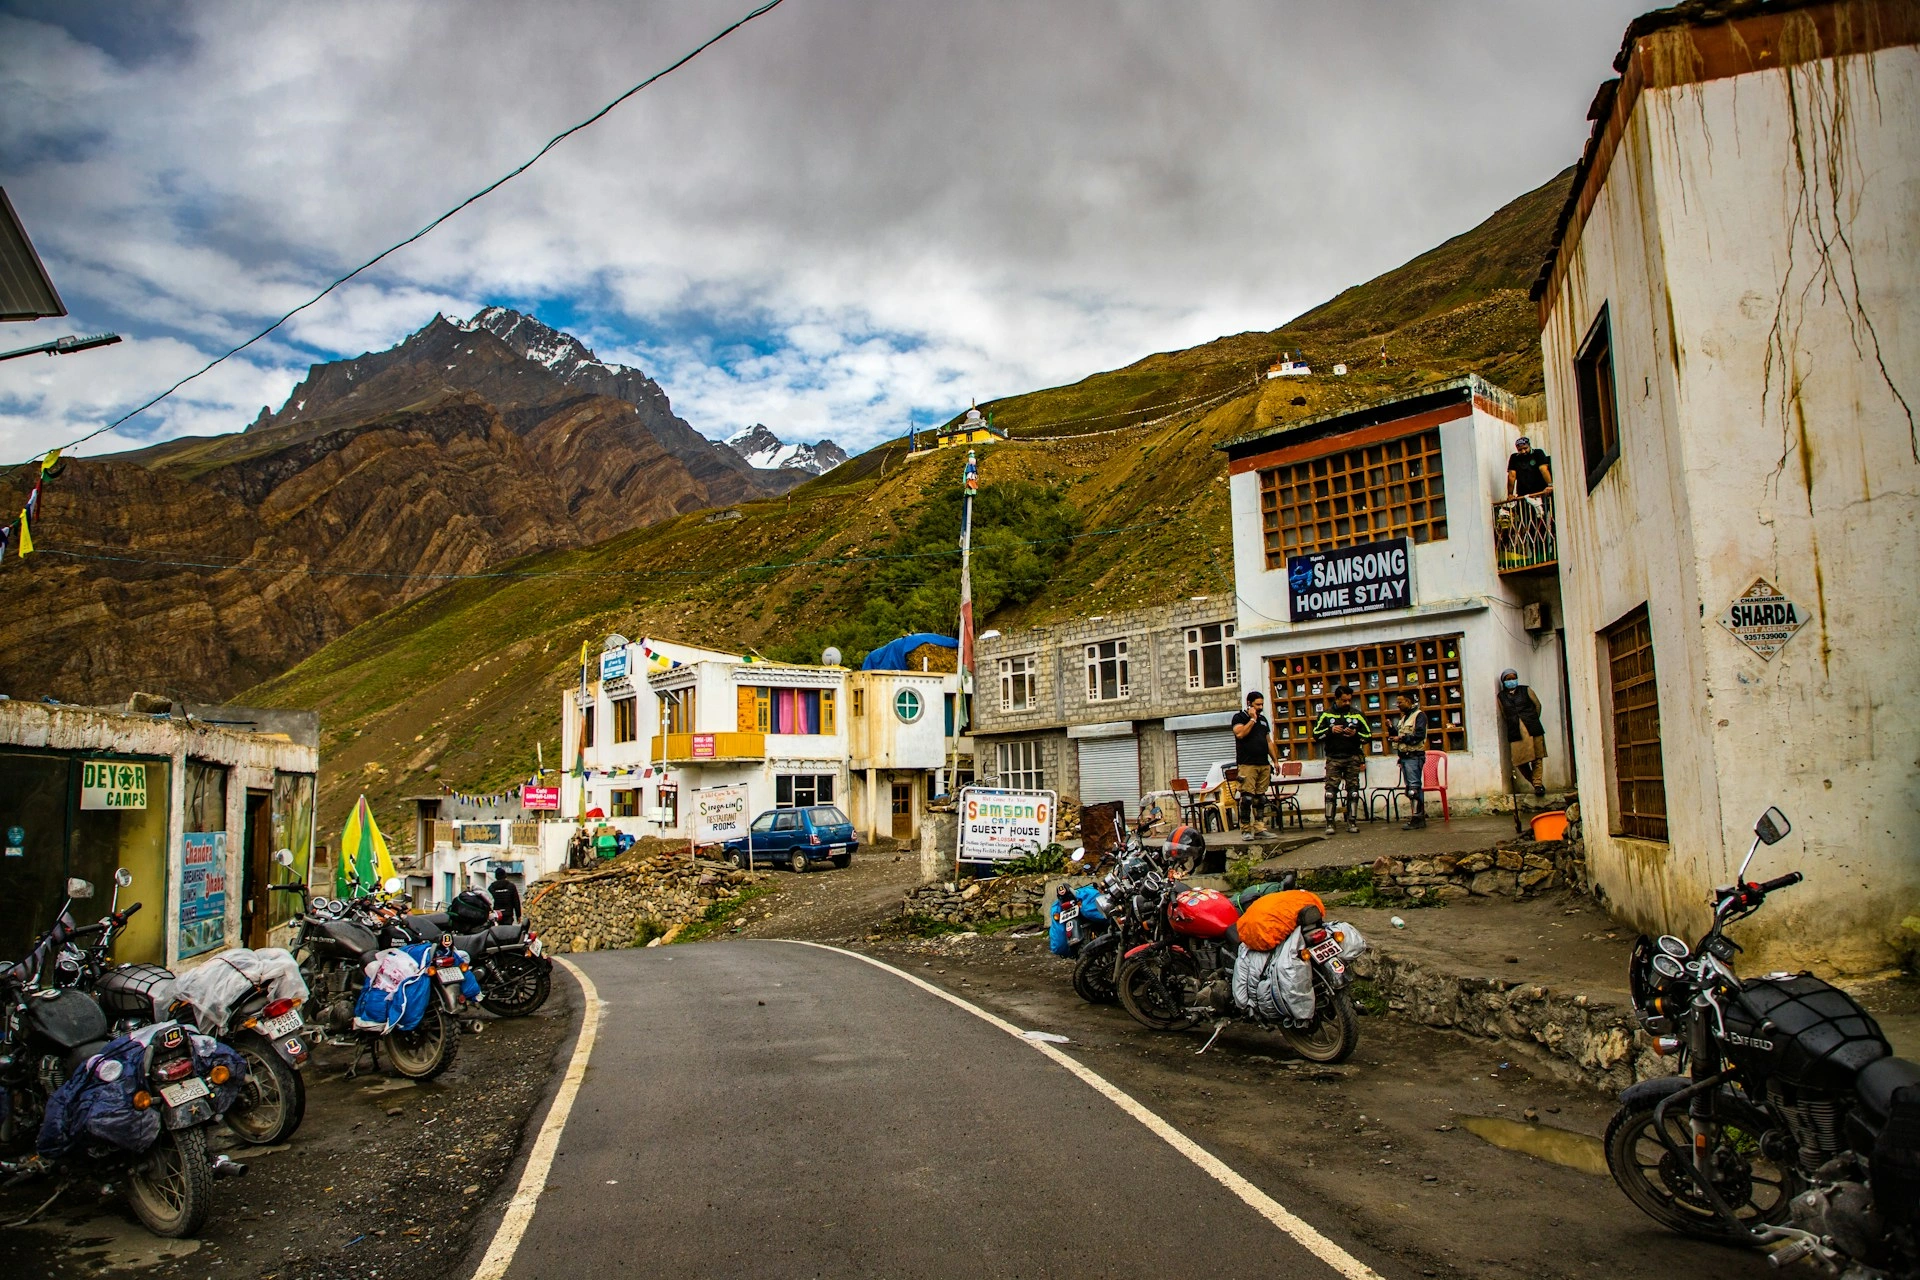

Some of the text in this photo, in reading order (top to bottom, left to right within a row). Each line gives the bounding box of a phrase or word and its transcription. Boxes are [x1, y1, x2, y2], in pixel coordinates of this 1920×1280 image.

[1314, 549, 1406, 588] SAMSONG
[1296, 588, 1350, 613] HOME
[1355, 579, 1406, 604] STAY
[1750, 586, 1772, 597] 39
[1740, 596, 1785, 604] CHANDIGARH
[1731, 603, 1798, 628] SHARDA
[1735, 625, 1794, 634] FRUIT AGENCY
[106, 791, 146, 807] CAMPS
[712, 821, 736, 832] ROOMS
[971, 825, 1040, 837] GUEST HOUSE
[185, 839, 213, 866] Chandra
[183, 868, 207, 885] BREAKFAST
[205, 872, 224, 900] Dhaba
[1316, 946, 1341, 961] 9091
[168, 1031, 179, 1041] 16
[1730, 1031, 1774, 1051] ENFIELD
